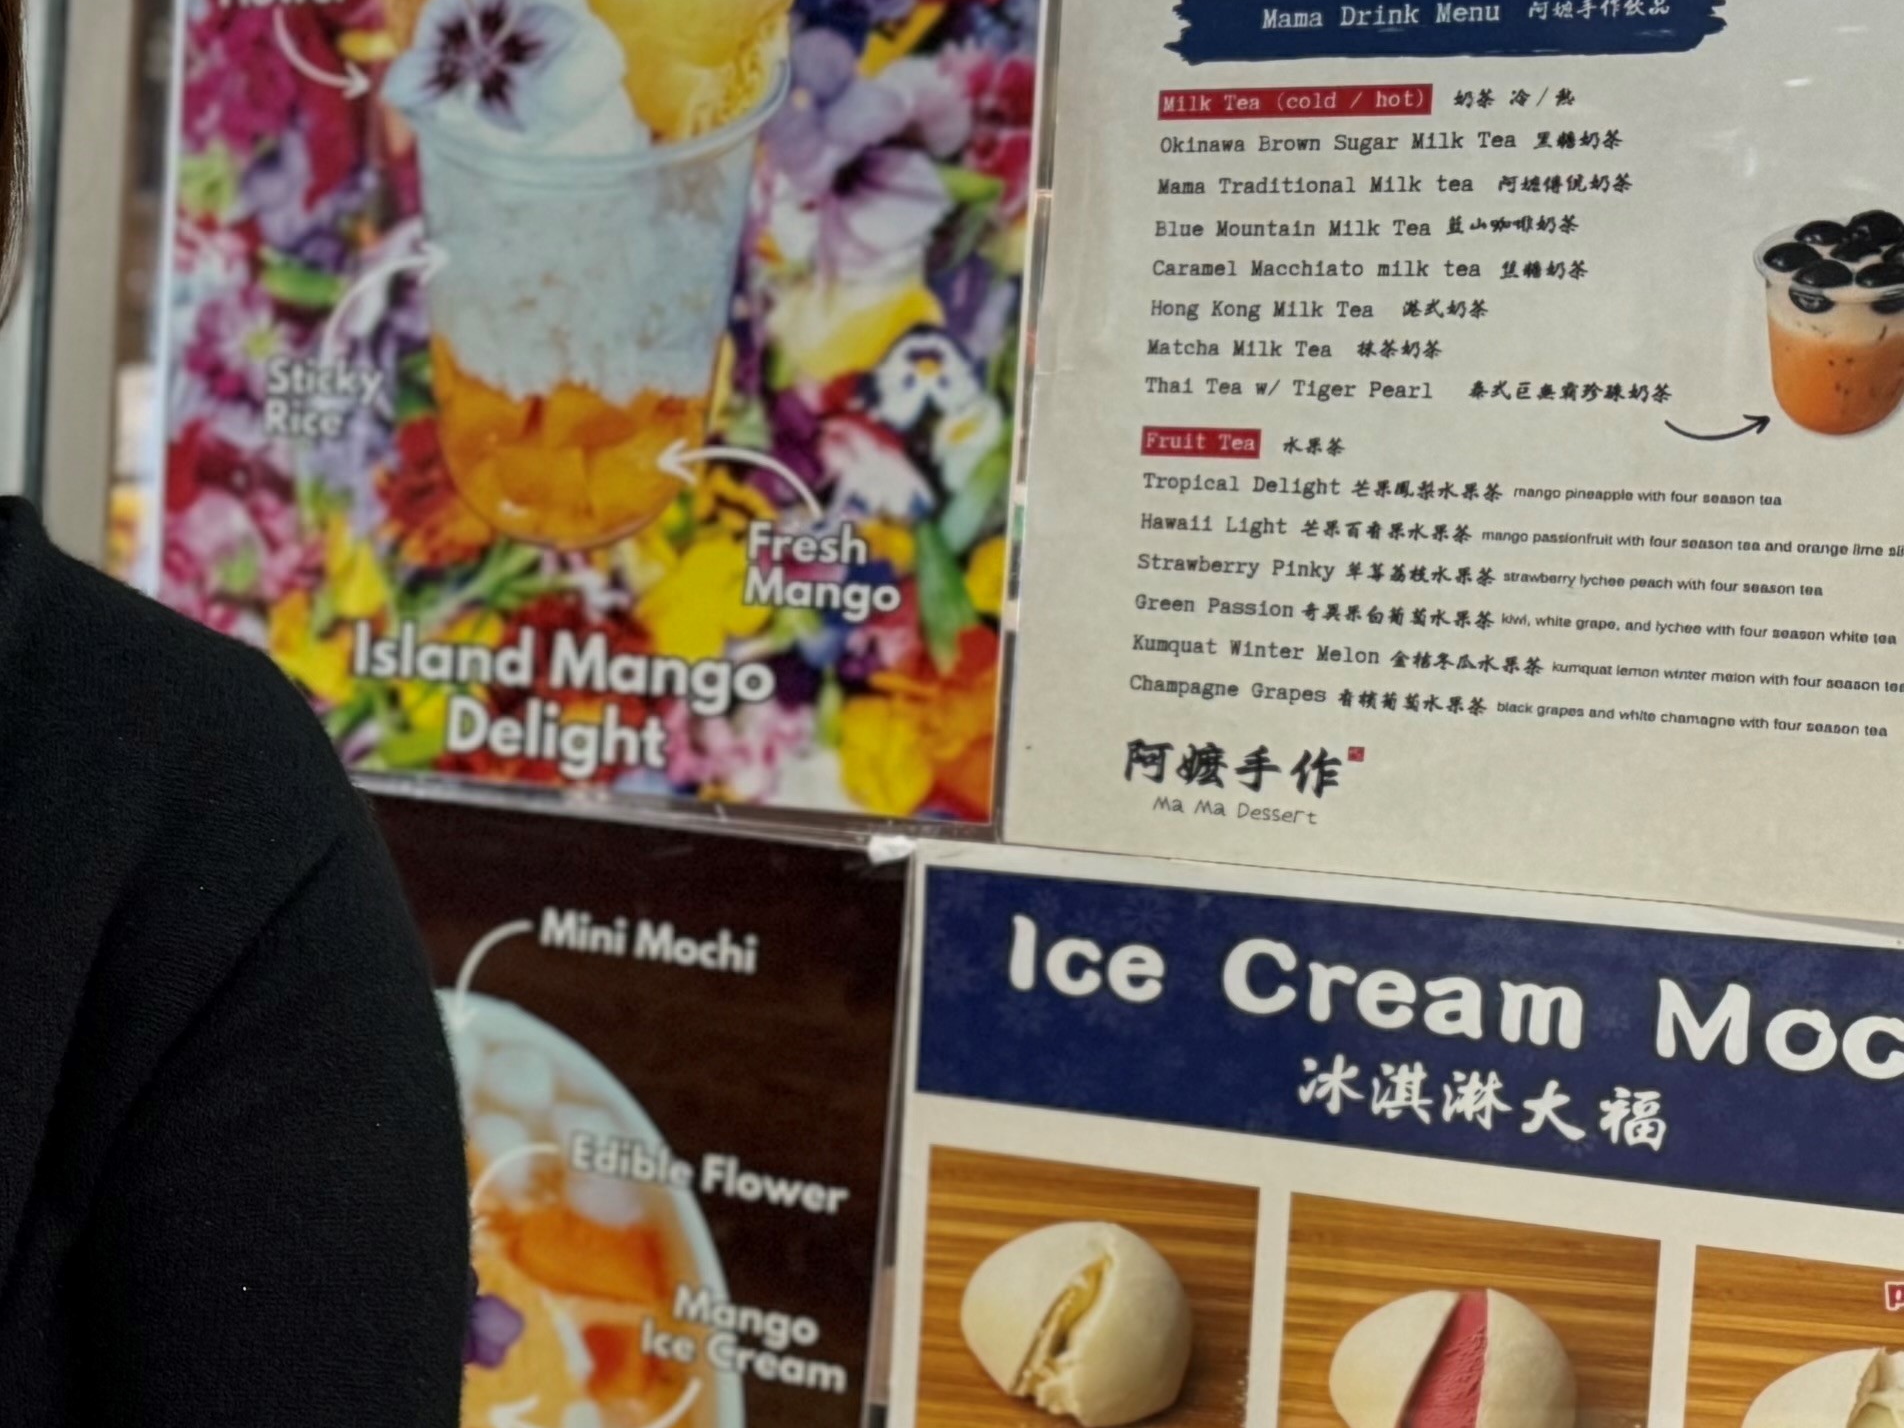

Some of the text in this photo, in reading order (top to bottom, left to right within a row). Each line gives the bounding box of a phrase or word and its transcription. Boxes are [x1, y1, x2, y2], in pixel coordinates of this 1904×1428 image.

[1262, 2, 1501, 30] Mama Drink Menu
[1162, 88, 1426, 113] Milk Tea (cold hot)
[1160, 136, 1245, 154] Okinawa
[1258, 134, 1321, 153] Brown
[1333, 135, 1399, 156] Sugar
[1411, 132, 1464, 150] Milk
[1477, 132, 1517, 150] Tea
[1157, 175, 1474, 196] Mama Traditional Milk tea
[1155, 219, 1432, 238] Blue Mountain Milk Tea
[1152, 259, 1481, 278] Caramel Macchiato milk tea
[1150, 300, 1200, 321] Hong
[1211, 300, 1261, 322] Kong
[1272, 301, 1324, 318] Milk
[1337, 300, 1374, 318] Tea
[1147, 338, 1220, 357] Matcha
[1232, 339, 1282, 357] Milk
[1295, 340, 1332, 357] Tea
[264, 359, 385, 406] Sticky
[1145, 376, 1433, 402] Thai Tea Tiger Pearl
[263, 402, 344, 440] Rice
[1146, 432, 1256, 452] Fruit Tea
[1142, 472, 1341, 500] Tropical Delight
[1140, 512, 1287, 539] Hawaii Light
[747, 520, 869, 567] Fresh
[1137, 553, 1335, 583] Strawberry Pinky
[743, 565, 902, 623] Mango
[1135, 593, 1294, 618] Green Passion
[1132, 634, 1380, 665] Kumquat Winter Melon
[353, 620, 777, 716] Island Mango
[1129, 674, 1327, 706] Champagne Grapes
[446, 697, 668, 779] Delight
[1153, 796, 1318, 825] Ma Ma Dessert
[538, 905, 760, 975] Mini Mochi
[1008, 913, 1166, 1004] Ice
[1222, 936, 1586, 1052] Cream
[1297, 1054, 1670, 1152] 冰淇淋大福
[569, 1131, 850, 1215] Edible Flower
[673, 1283, 820, 1351] Mango
[641, 1319, 848, 1394] Ice Cream
